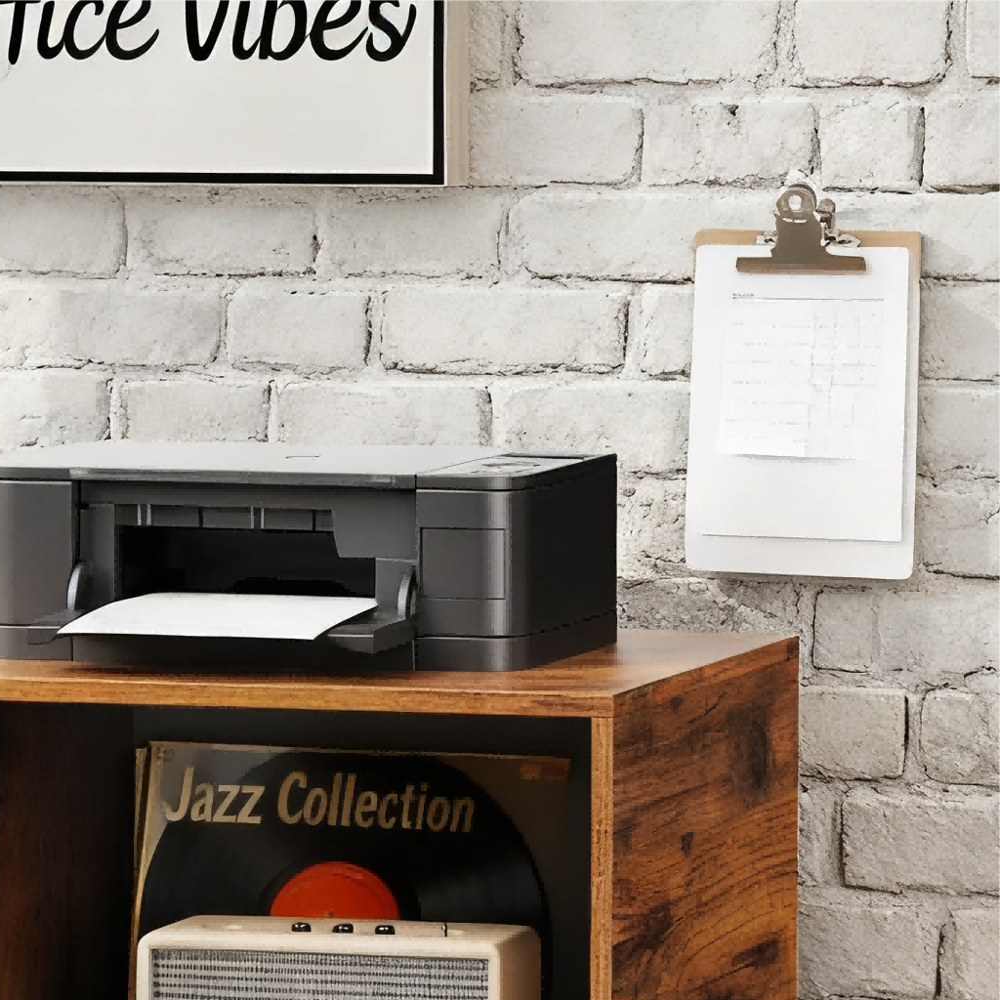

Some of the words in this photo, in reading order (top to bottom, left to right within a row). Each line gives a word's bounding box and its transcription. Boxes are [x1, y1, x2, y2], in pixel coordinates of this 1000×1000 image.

[185, 0, 417, 62] Vibes
[164, 766, 266, 824] Jazz
[277, 771, 475, 833] Collection
